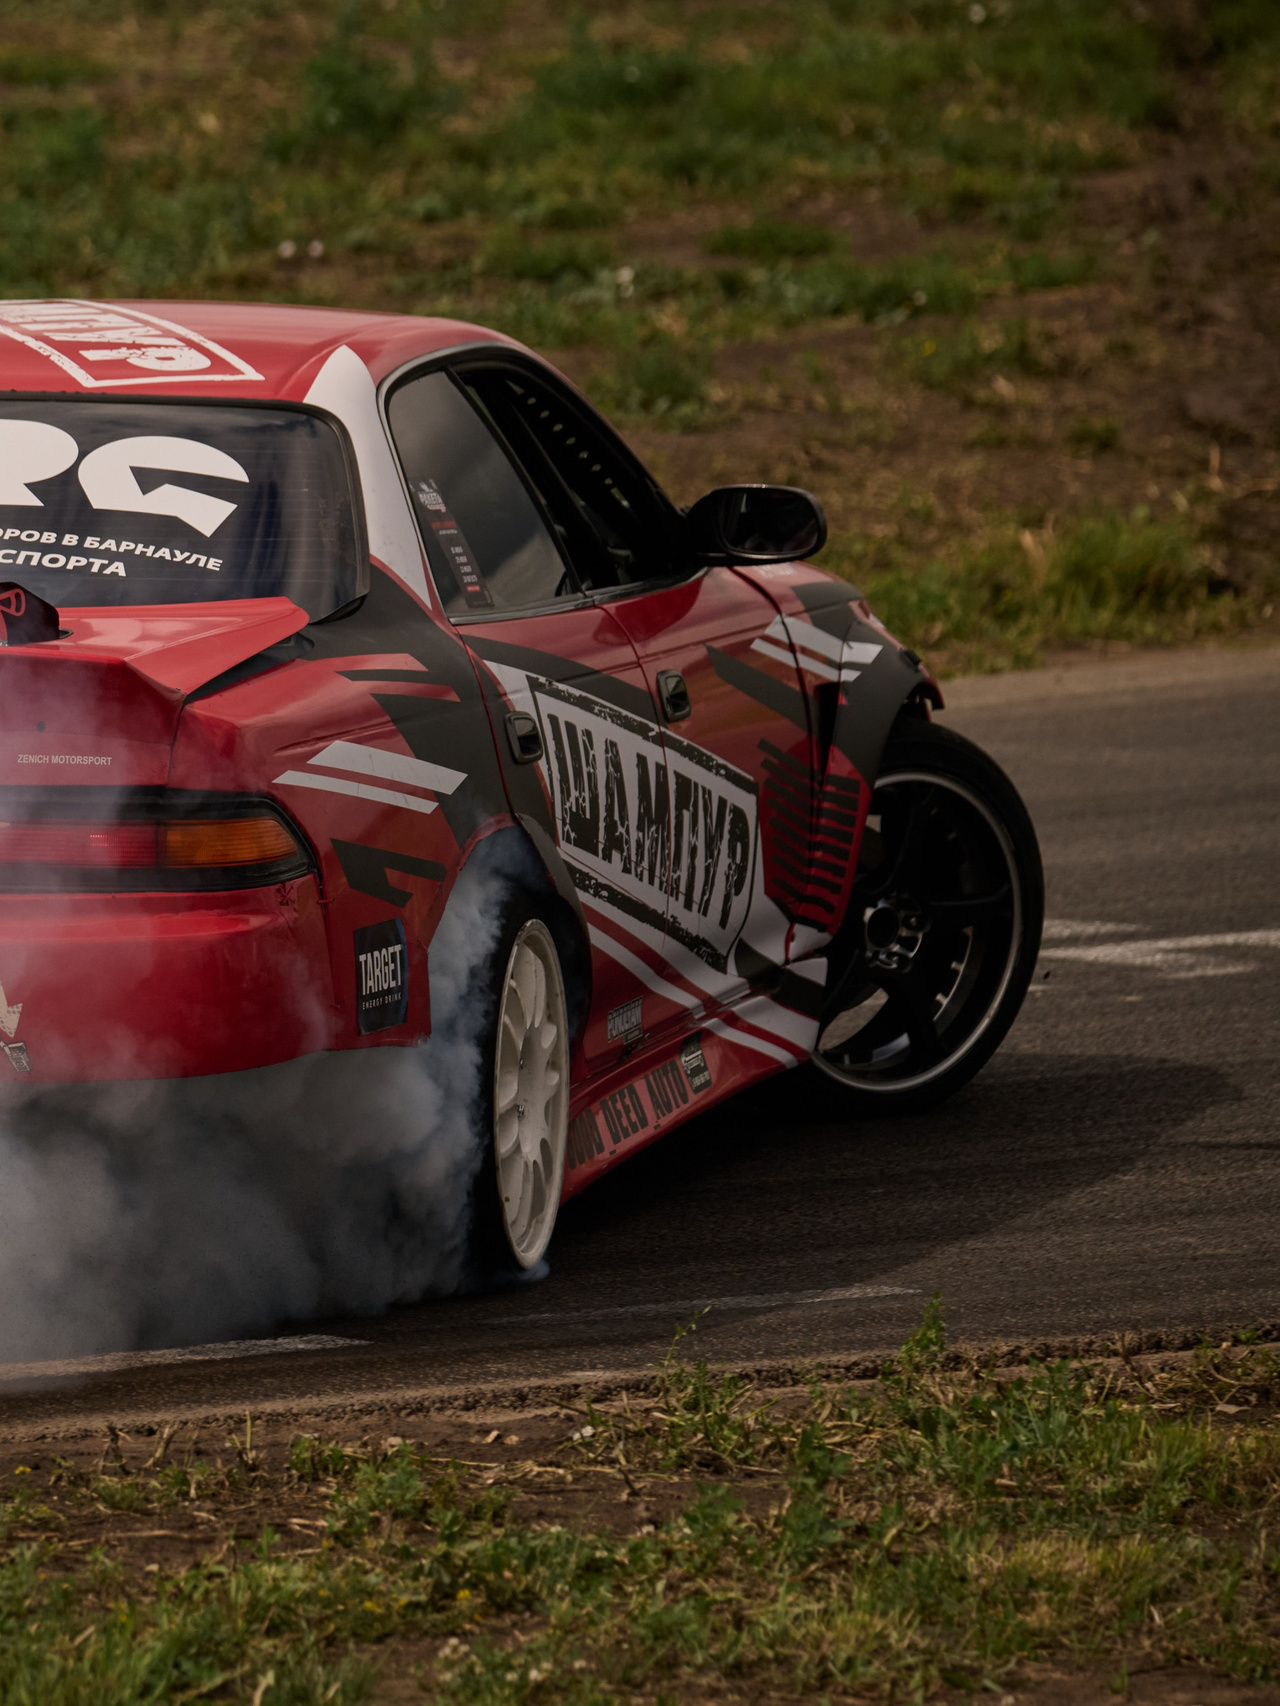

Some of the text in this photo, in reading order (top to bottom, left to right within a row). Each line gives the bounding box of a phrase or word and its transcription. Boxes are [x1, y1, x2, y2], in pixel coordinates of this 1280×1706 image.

[61, 533, 80, 547] В
[83, 536, 224, 572] БАРНАУЛЕ
[17, 754, 113, 766] ZENICH MOTORSPORT
[358, 944, 402, 996] TARGET
[362, 992, 402, 1010] ENERGY DRINK
